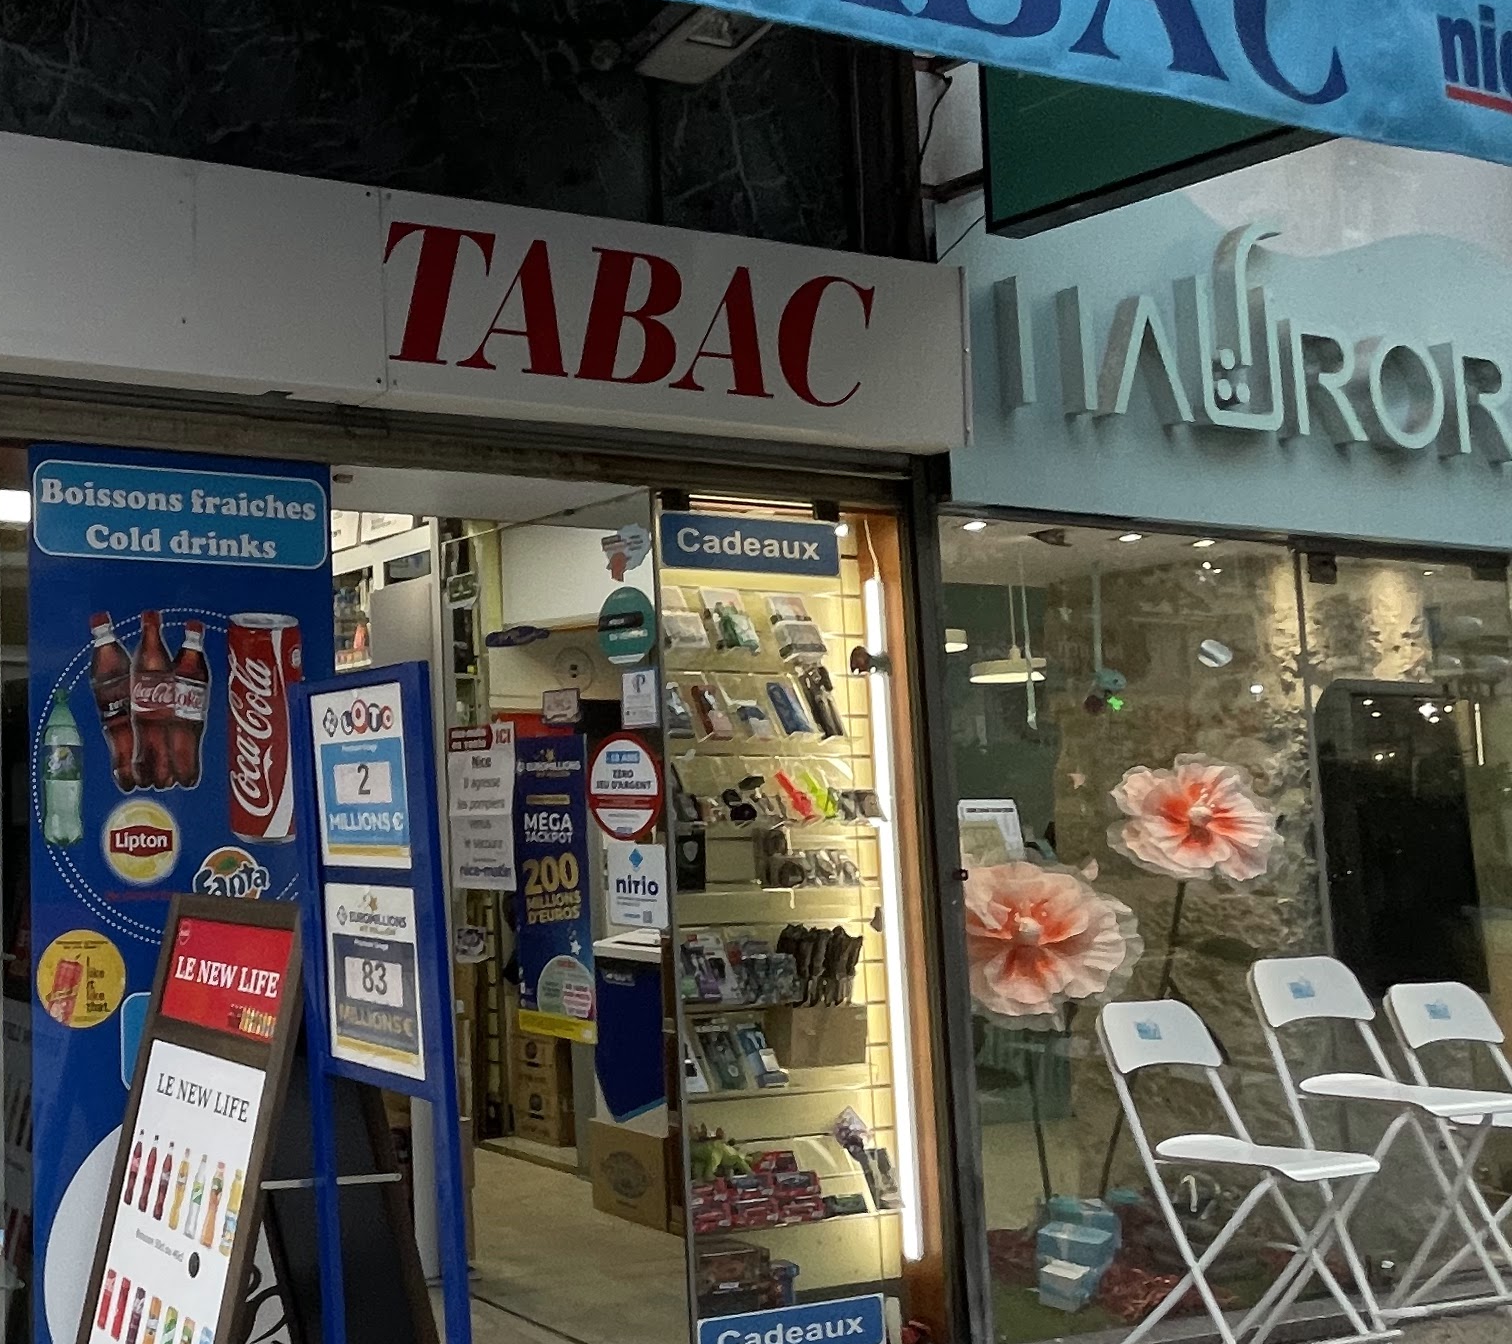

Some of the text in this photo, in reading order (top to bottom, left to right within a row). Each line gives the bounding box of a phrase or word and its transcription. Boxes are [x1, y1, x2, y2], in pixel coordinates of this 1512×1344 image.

[383, 222, 875, 407] TABAC
[40, 477, 182, 512] Boissons
[86, 524, 277, 559] Cold drinks
[677, 527, 820, 560] Cadeaux
[341, 699, 394, 735] LOTO
[357, 764, 370, 795] 2
[329, 812, 390, 832] MILLIONS
[115, 830, 169, 851] Lipton
[522, 852, 579, 895] 200
[175, 956, 280, 998] LE NEW LIFE
[362, 959, 387, 995] 83
[156, 1073, 250, 1123] LE NEW LIFE
